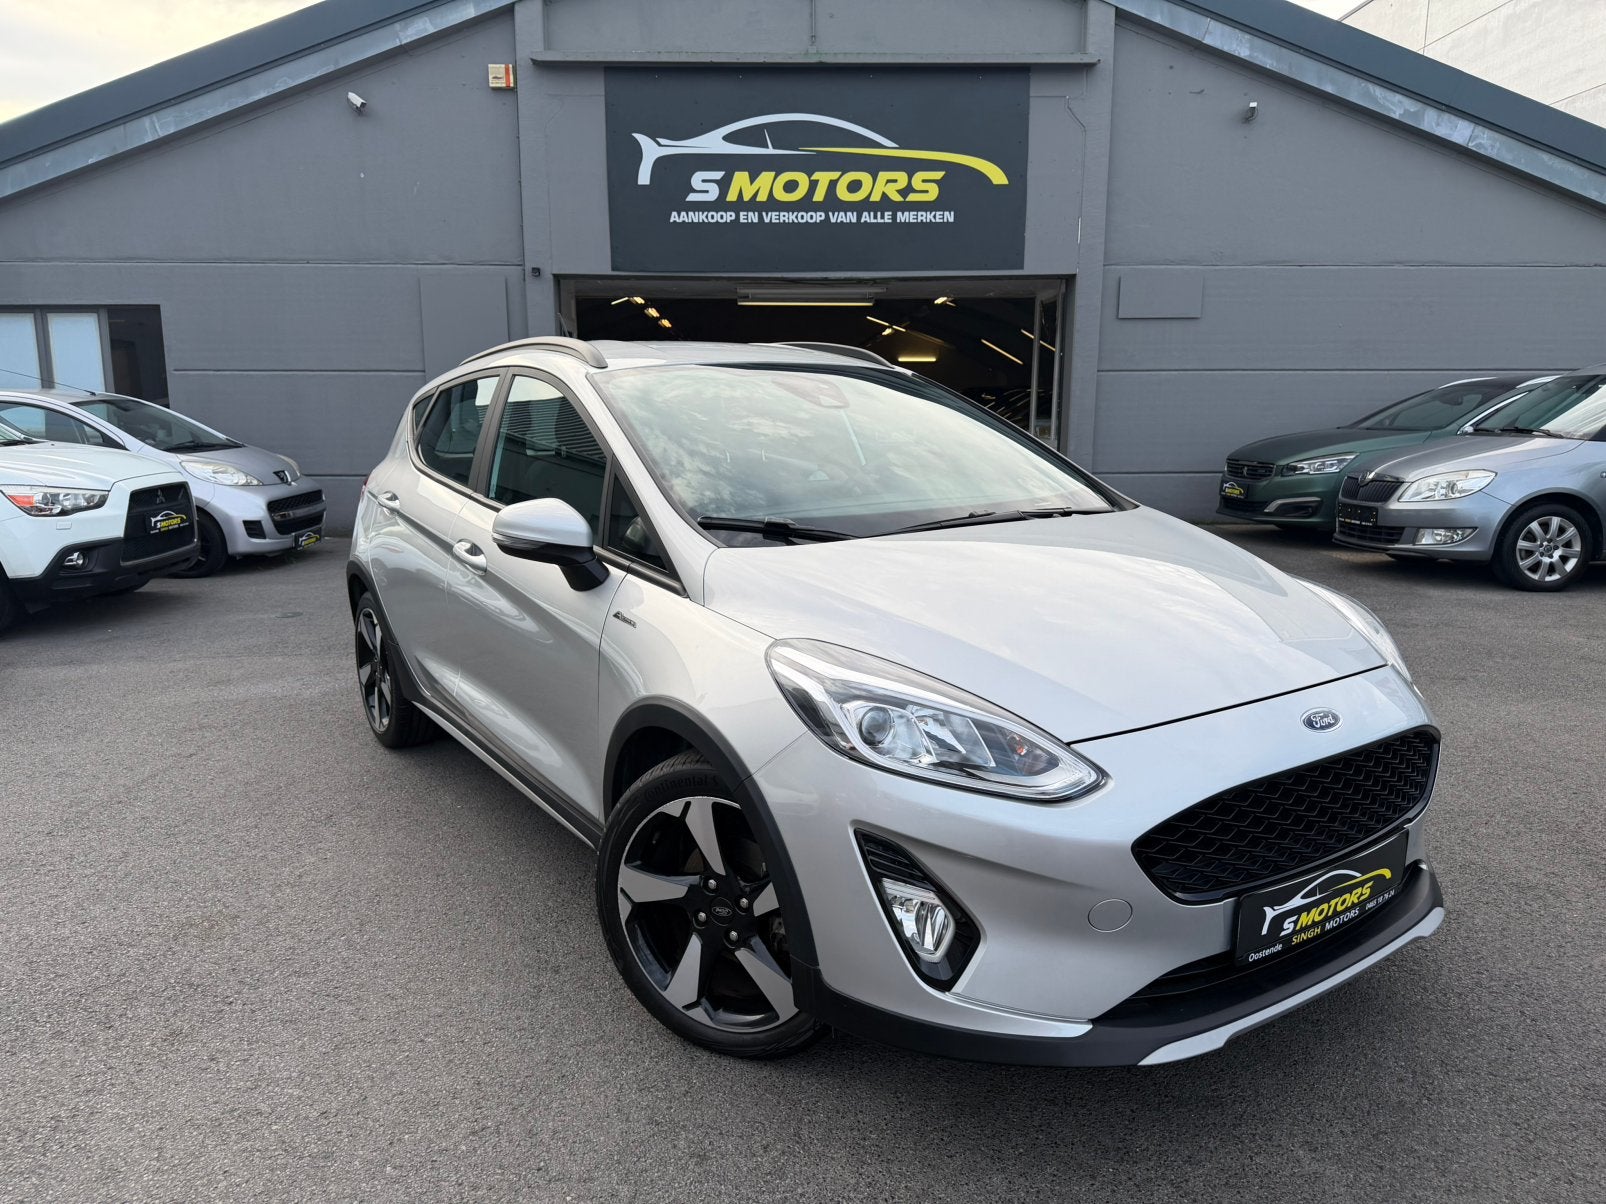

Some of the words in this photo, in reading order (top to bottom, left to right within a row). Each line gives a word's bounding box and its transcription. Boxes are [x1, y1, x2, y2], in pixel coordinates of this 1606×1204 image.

[669, 211, 736, 223] AANKOOP
[739, 211, 759, 223] EN
[762, 211, 825, 223] VERKOOP
[828, 211, 858, 223] VAN
[860, 211, 892, 223] ALLE
[896, 211, 955, 223] MERKEN
[1311, 712, 1335, 728] Ford
[1248, 943, 1283, 962] Oostende
[1291, 925, 1321, 946] SINGH
[1324, 907, 1360, 931] MOTORS
